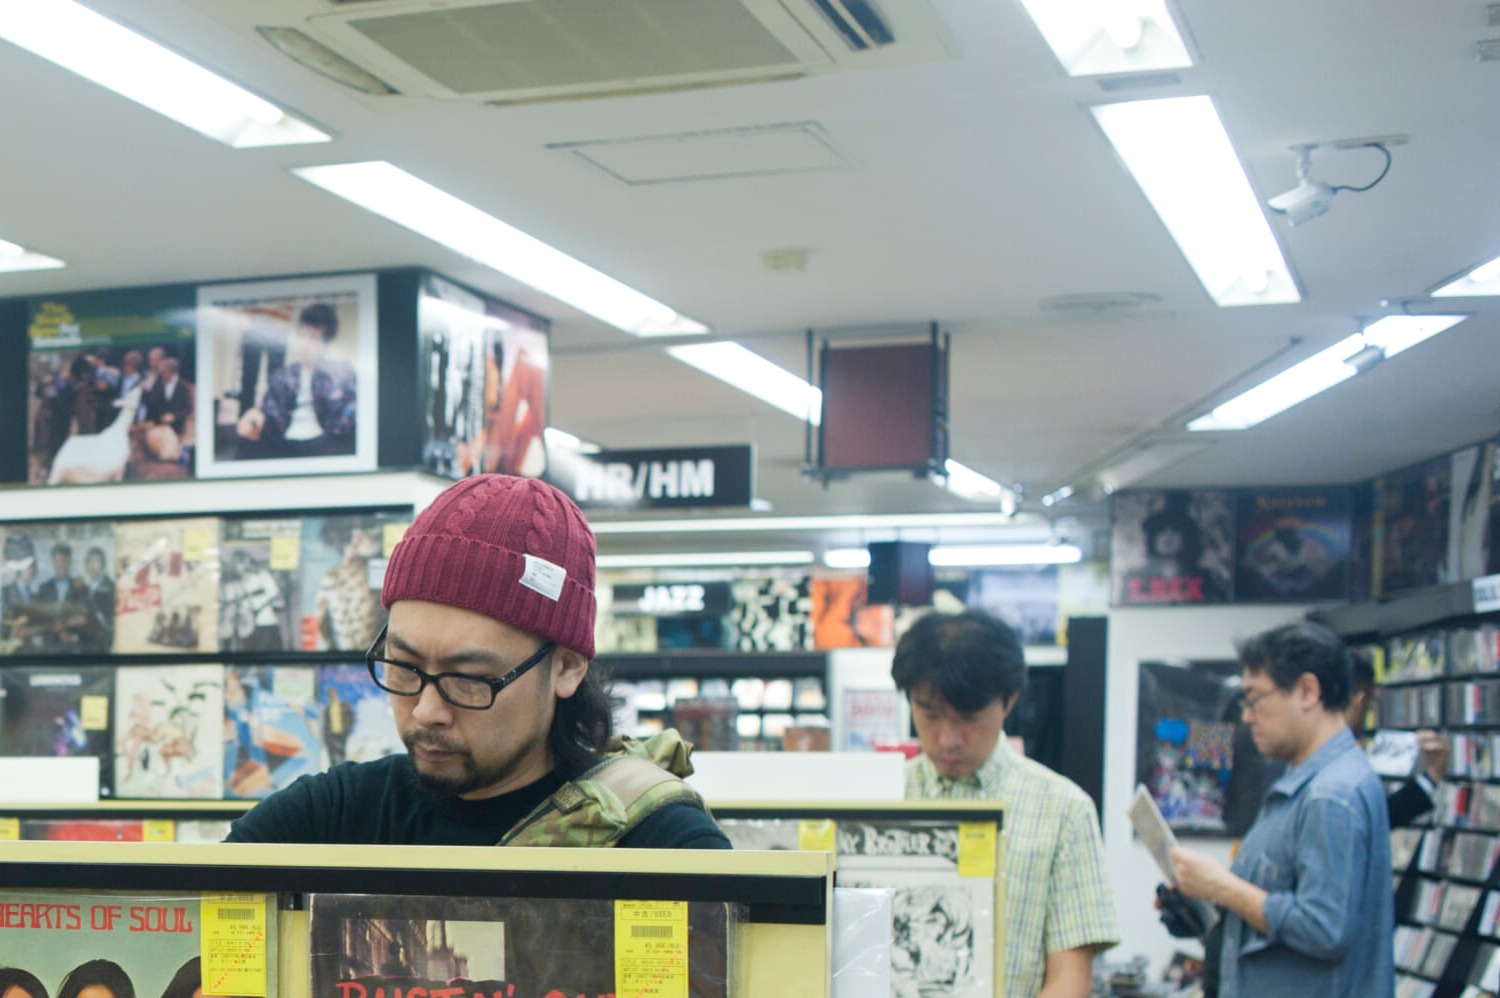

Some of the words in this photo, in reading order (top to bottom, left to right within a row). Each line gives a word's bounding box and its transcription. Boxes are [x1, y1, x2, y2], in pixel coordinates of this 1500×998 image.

[576, 459, 715, 501] HR/HM
[638, 585, 705, 612] JAZZ
[90, 905, 123, 931] OF
[129, 906, 194, 934] SOUL
